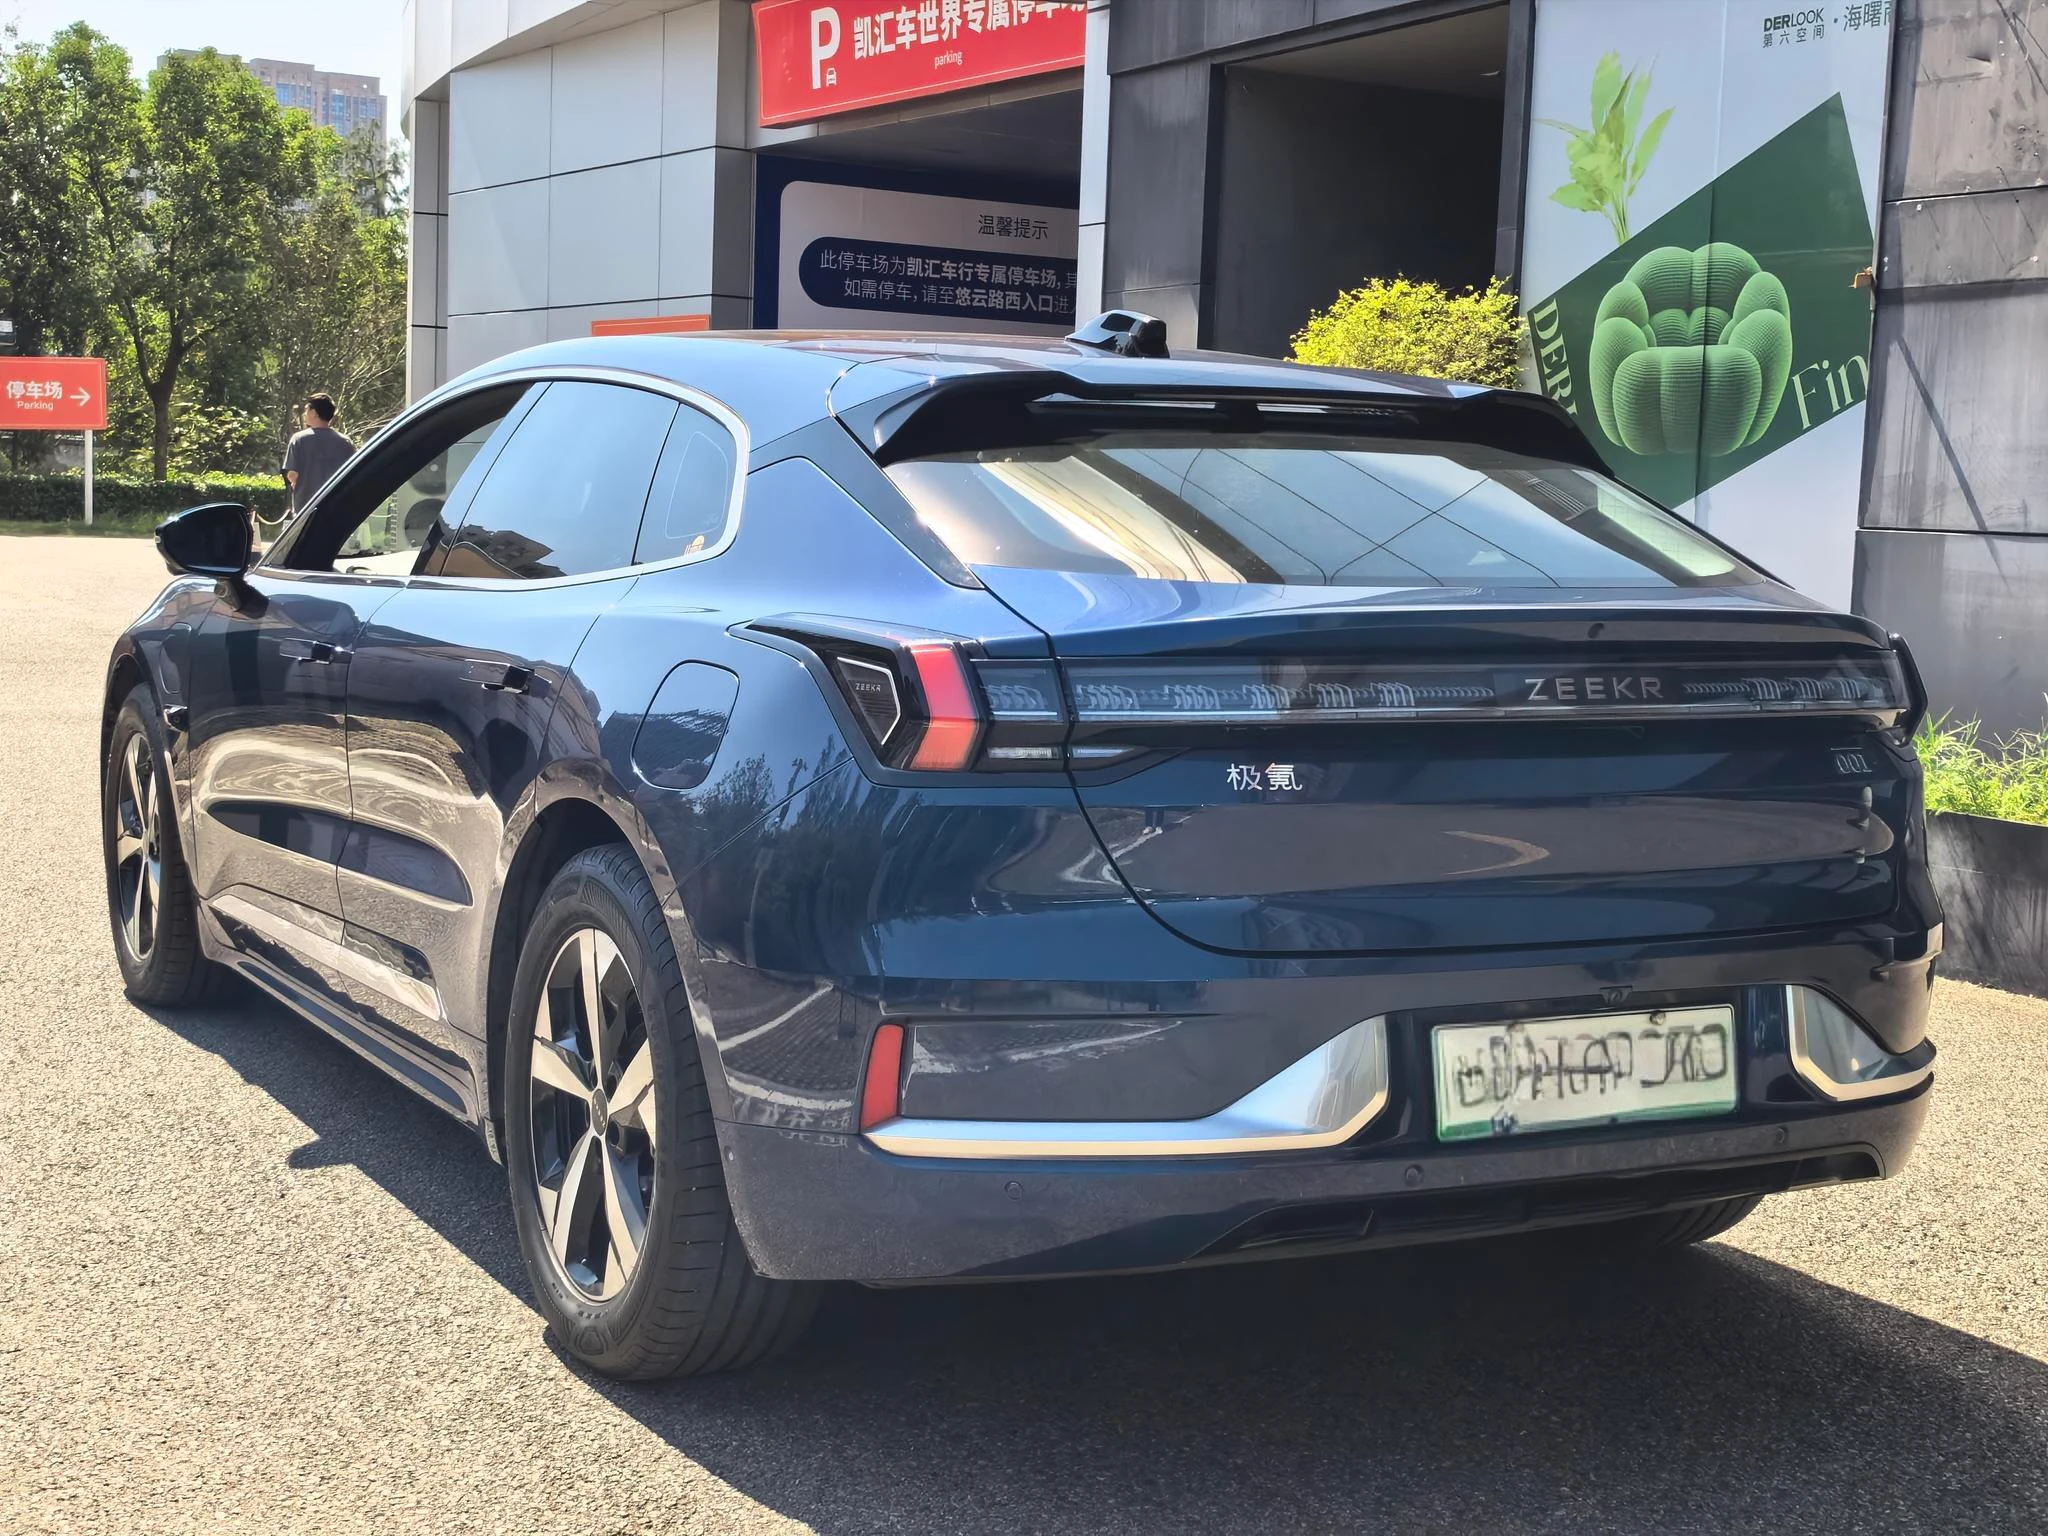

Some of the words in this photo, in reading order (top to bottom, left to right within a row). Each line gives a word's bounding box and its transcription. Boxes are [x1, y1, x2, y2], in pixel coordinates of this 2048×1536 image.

[853, 0, 1086, 60] 凯汇车世界专属停
[1763, 8, 1824, 32] DERLOOK
[1763, 24, 1825, 48] 第六空间
[811, 7, 841, 90] P
[934, 50, 963, 70] parking
[978, 214, 1048, 241] 温馨提示
[6, 381, 63, 399] 停车场
[17, 401, 54, 411] Parking
[855, 682, 881, 693] ZEEKR
[1526, 677, 1664, 701] ZEEKR
[1835, 753, 1872, 774] 001
[1226, 763, 1303, 792] 极氪
